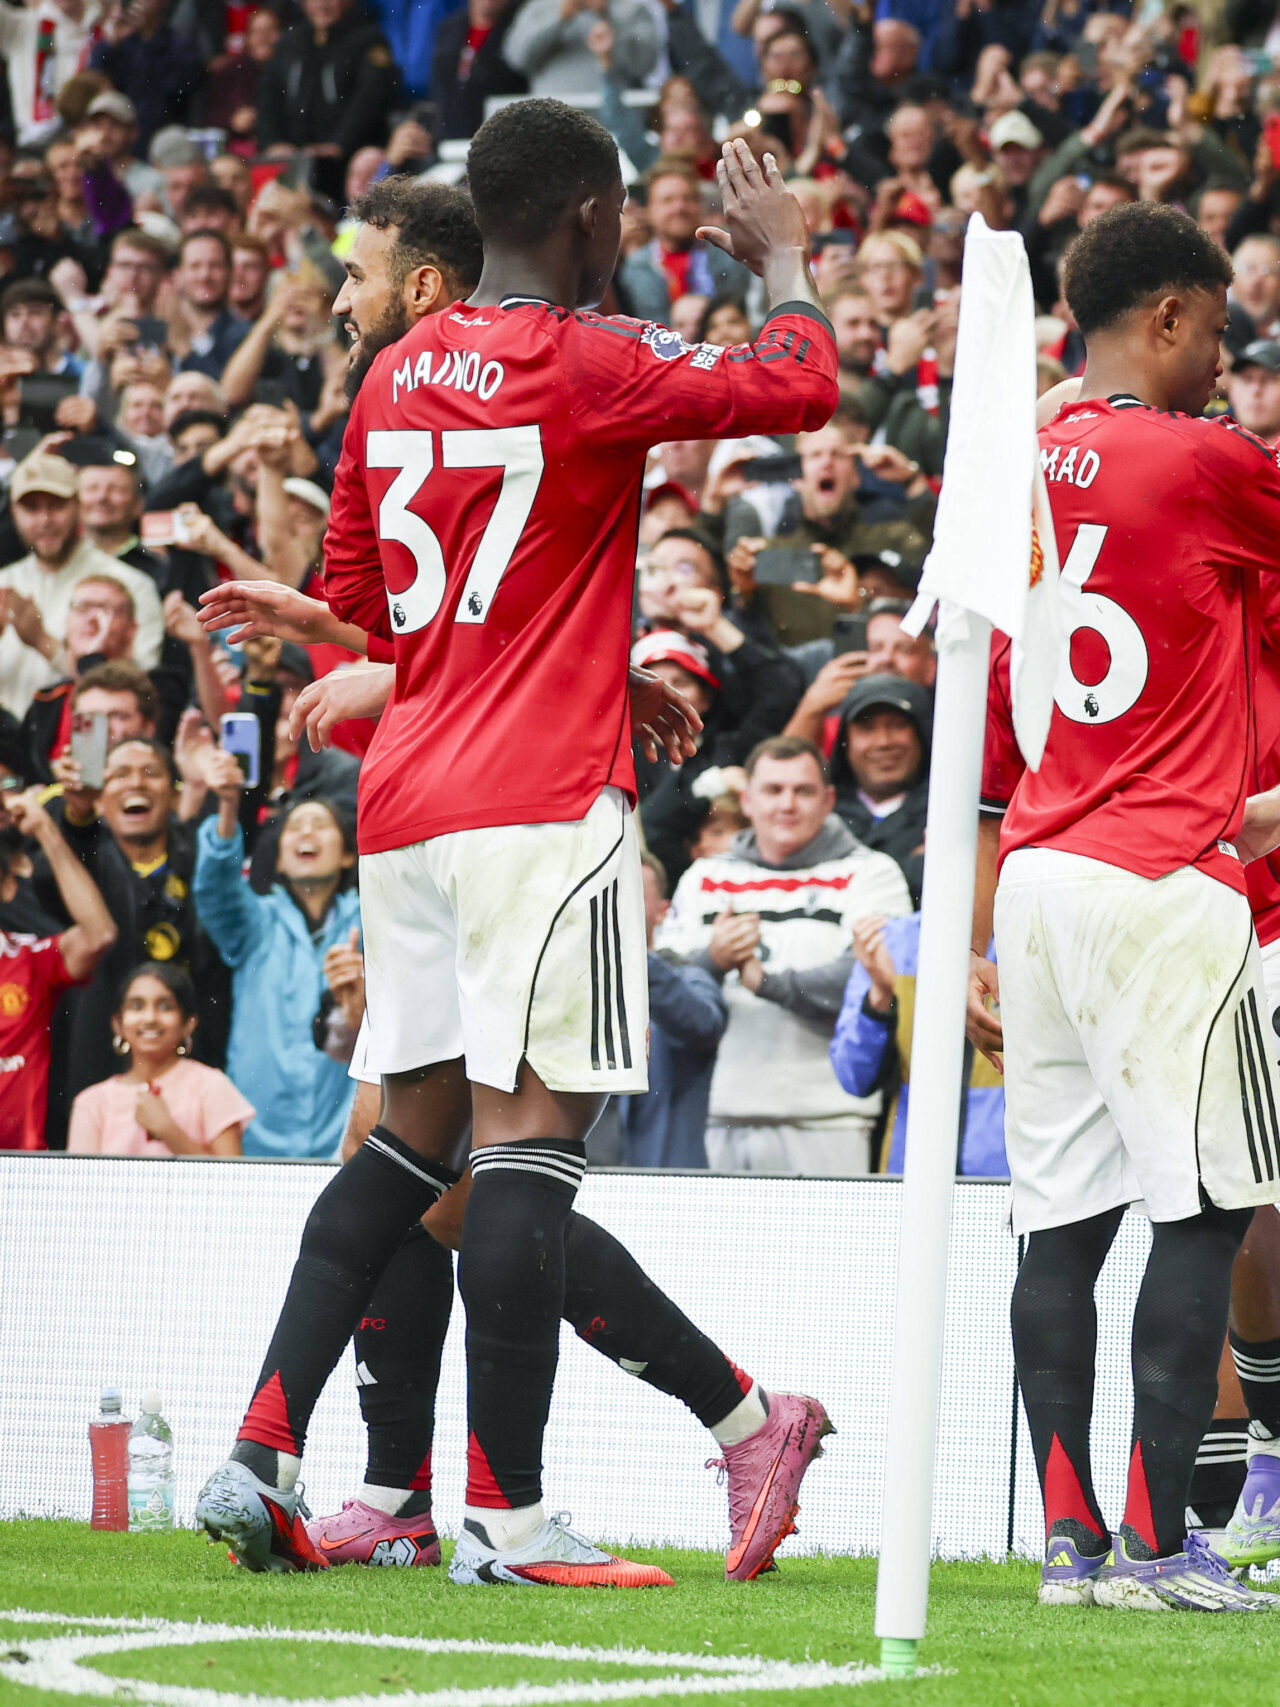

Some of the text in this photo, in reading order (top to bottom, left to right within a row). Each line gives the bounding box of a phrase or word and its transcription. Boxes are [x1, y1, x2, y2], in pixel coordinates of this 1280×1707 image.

[393, 350, 505, 405] MAINOO
[1039, 446, 1101, 489] MAD
[366, 424, 545, 635] 37
[1053, 522, 1150, 725] 6
[360, 1317, 387, 1331] FC
